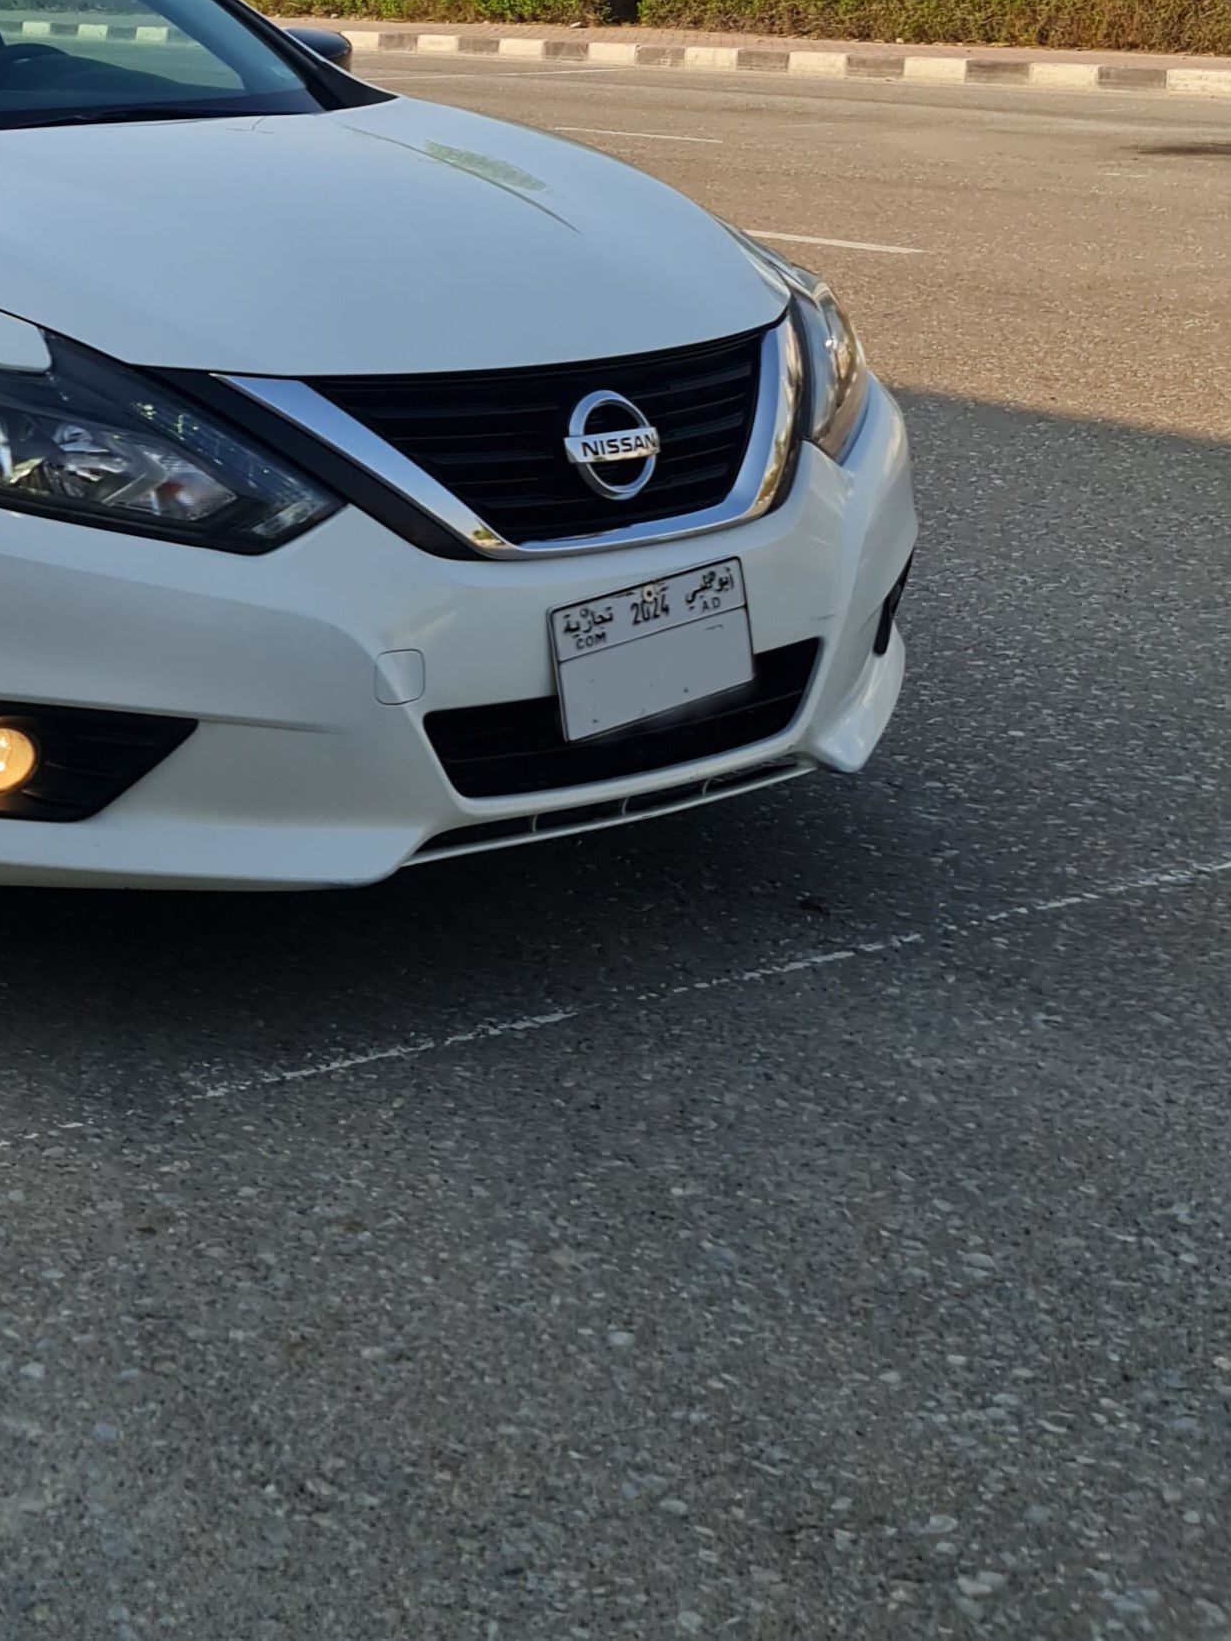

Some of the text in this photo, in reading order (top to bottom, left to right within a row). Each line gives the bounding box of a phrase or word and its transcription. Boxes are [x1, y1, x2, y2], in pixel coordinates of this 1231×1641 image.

[581, 434, 656, 457] NISSAN
[630, 593, 670, 626] 2024
[576, 631, 607, 650] COM
